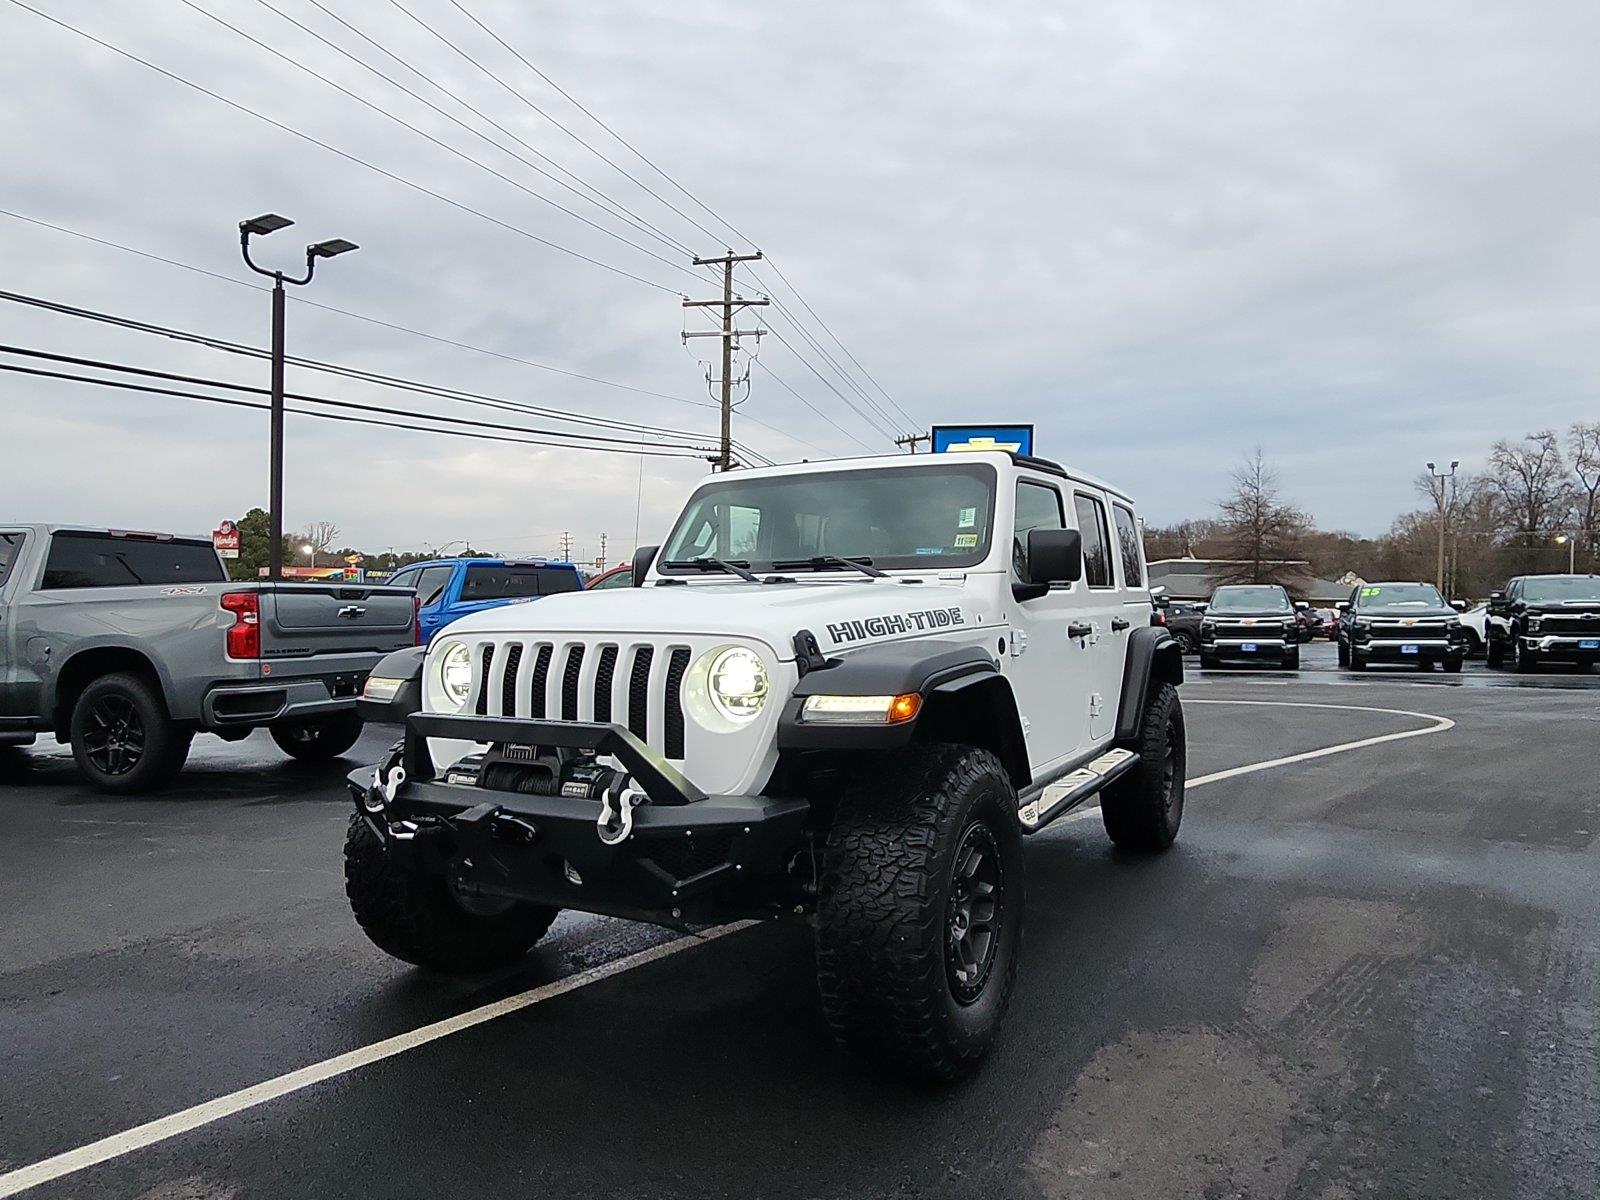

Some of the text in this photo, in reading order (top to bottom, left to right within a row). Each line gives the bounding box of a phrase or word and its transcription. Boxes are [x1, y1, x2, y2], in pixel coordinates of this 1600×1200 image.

[1362, 588, 1380, 596] 25
[826, 607, 964, 644] HIGH TIDE
